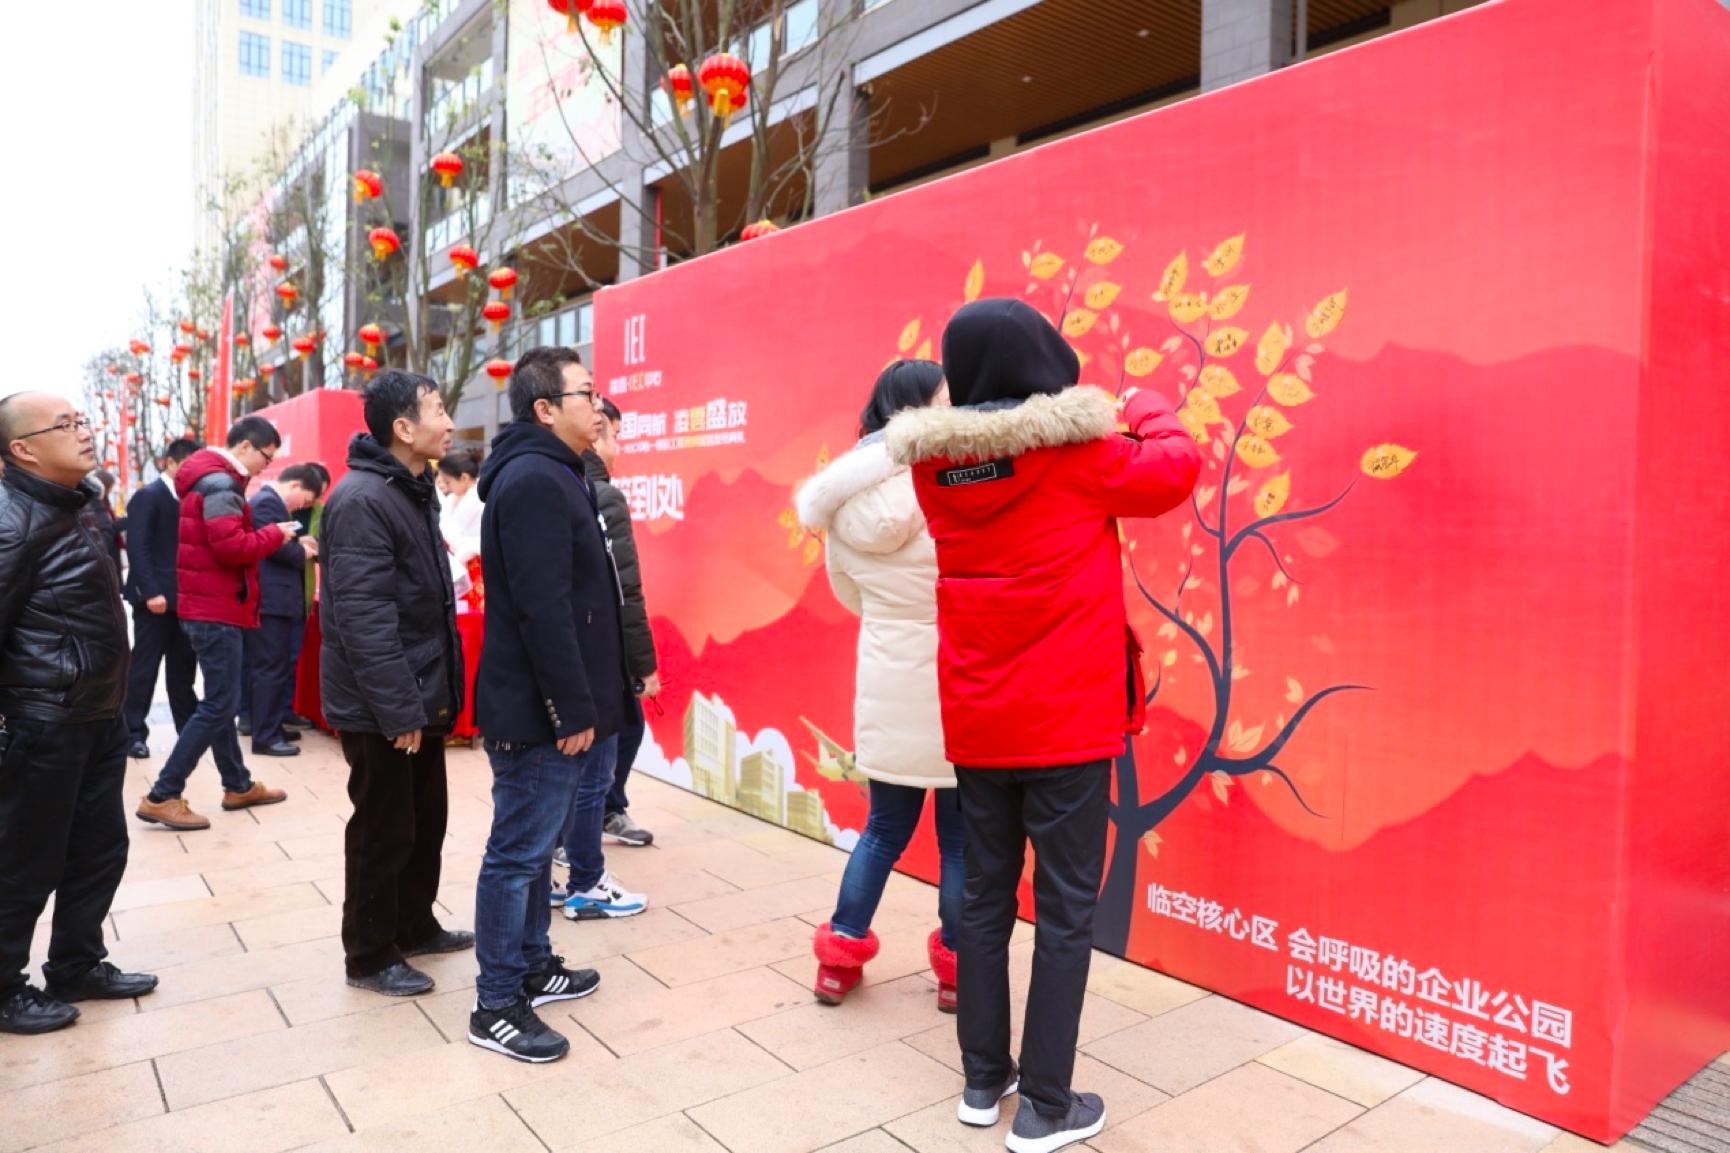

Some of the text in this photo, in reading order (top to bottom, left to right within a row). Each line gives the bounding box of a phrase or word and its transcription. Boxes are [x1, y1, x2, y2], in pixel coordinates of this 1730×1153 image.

[617, 410, 667, 440] 国同航
[1147, 883, 1573, 1049] 临空核心区 会呼吸的企业公园
[1286, 965, 1572, 1096] 以世界的速度起飞
